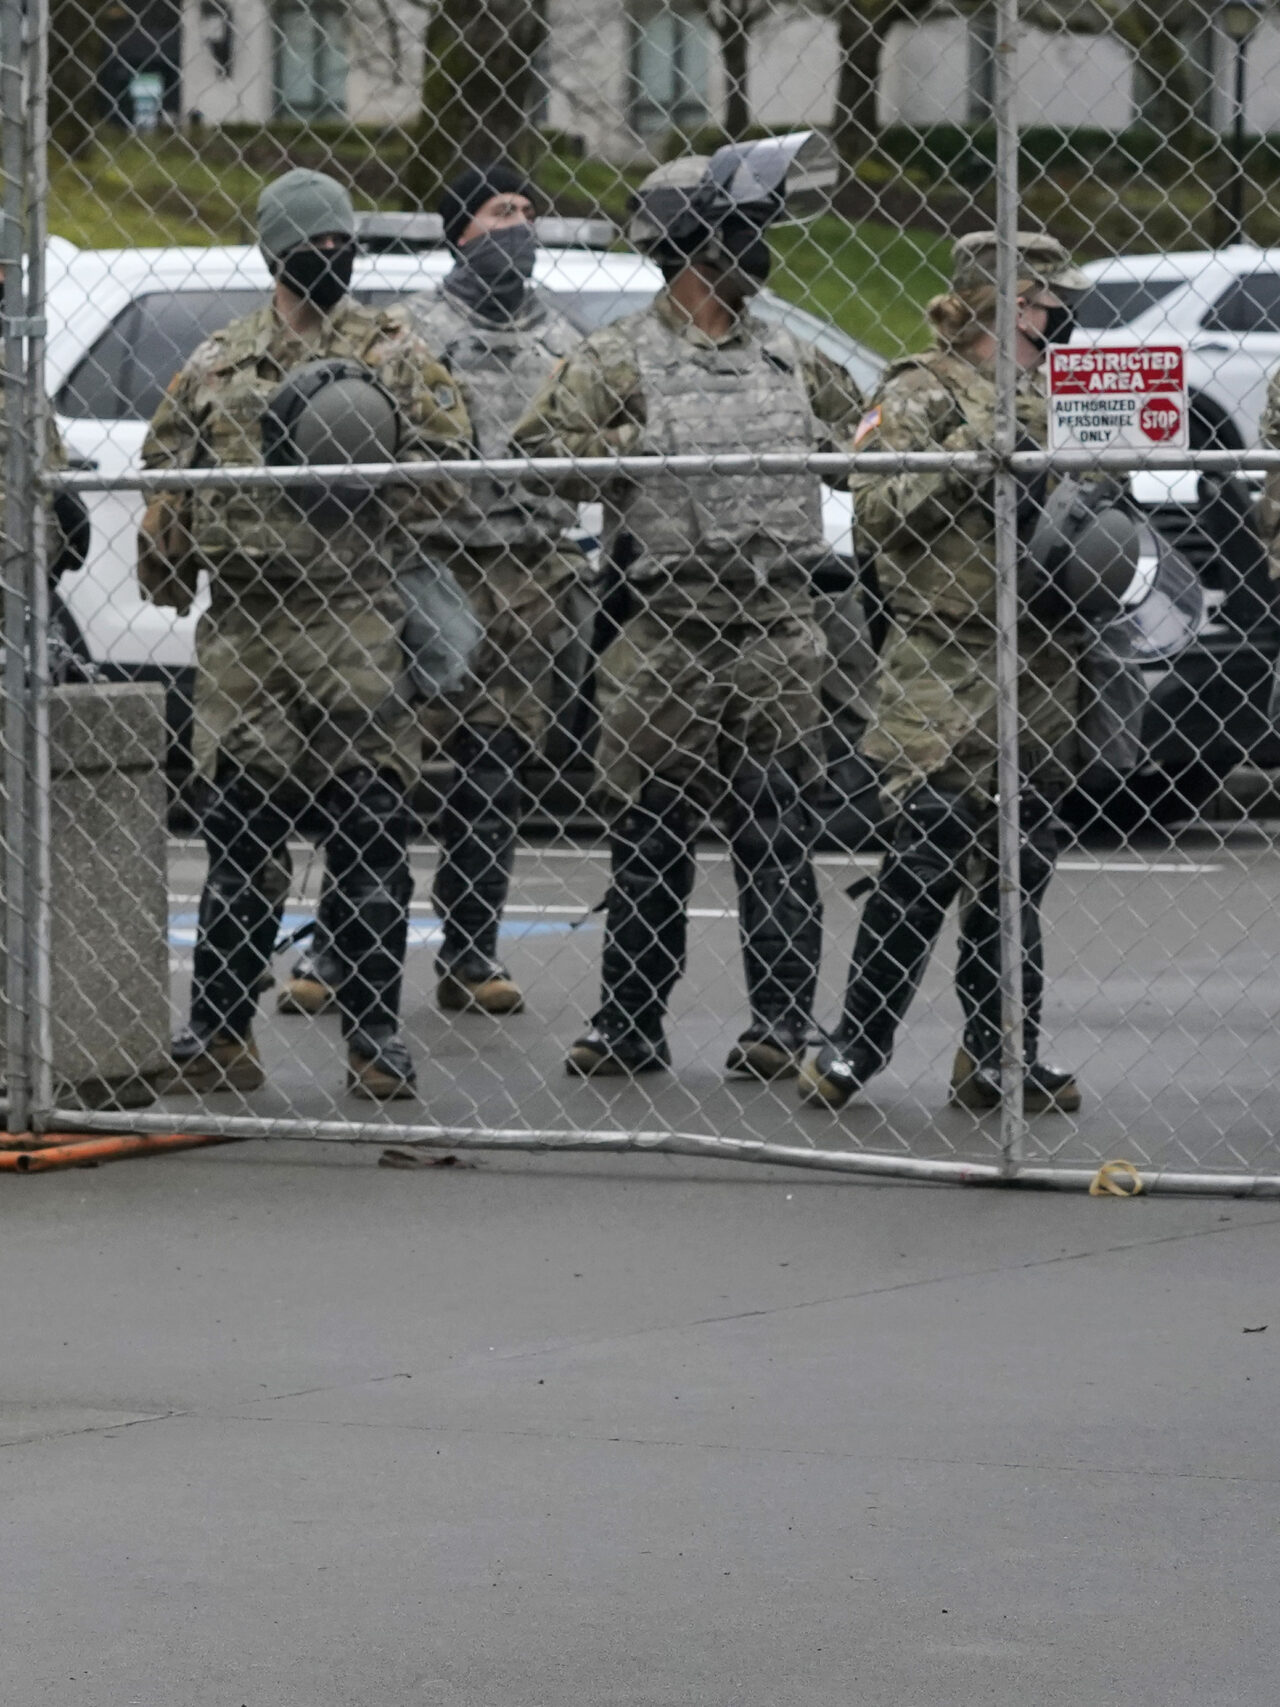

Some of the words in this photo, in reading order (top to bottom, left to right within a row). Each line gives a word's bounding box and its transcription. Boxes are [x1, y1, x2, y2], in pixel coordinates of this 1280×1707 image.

[1054, 352, 1178, 372] RESTRICTED
[1088, 372, 1145, 391] AREA
[1055, 400, 1136, 412] AUTHORIZED
[1142, 410, 1178, 430] STOP
[1080, 430, 1112, 442] ONLY
